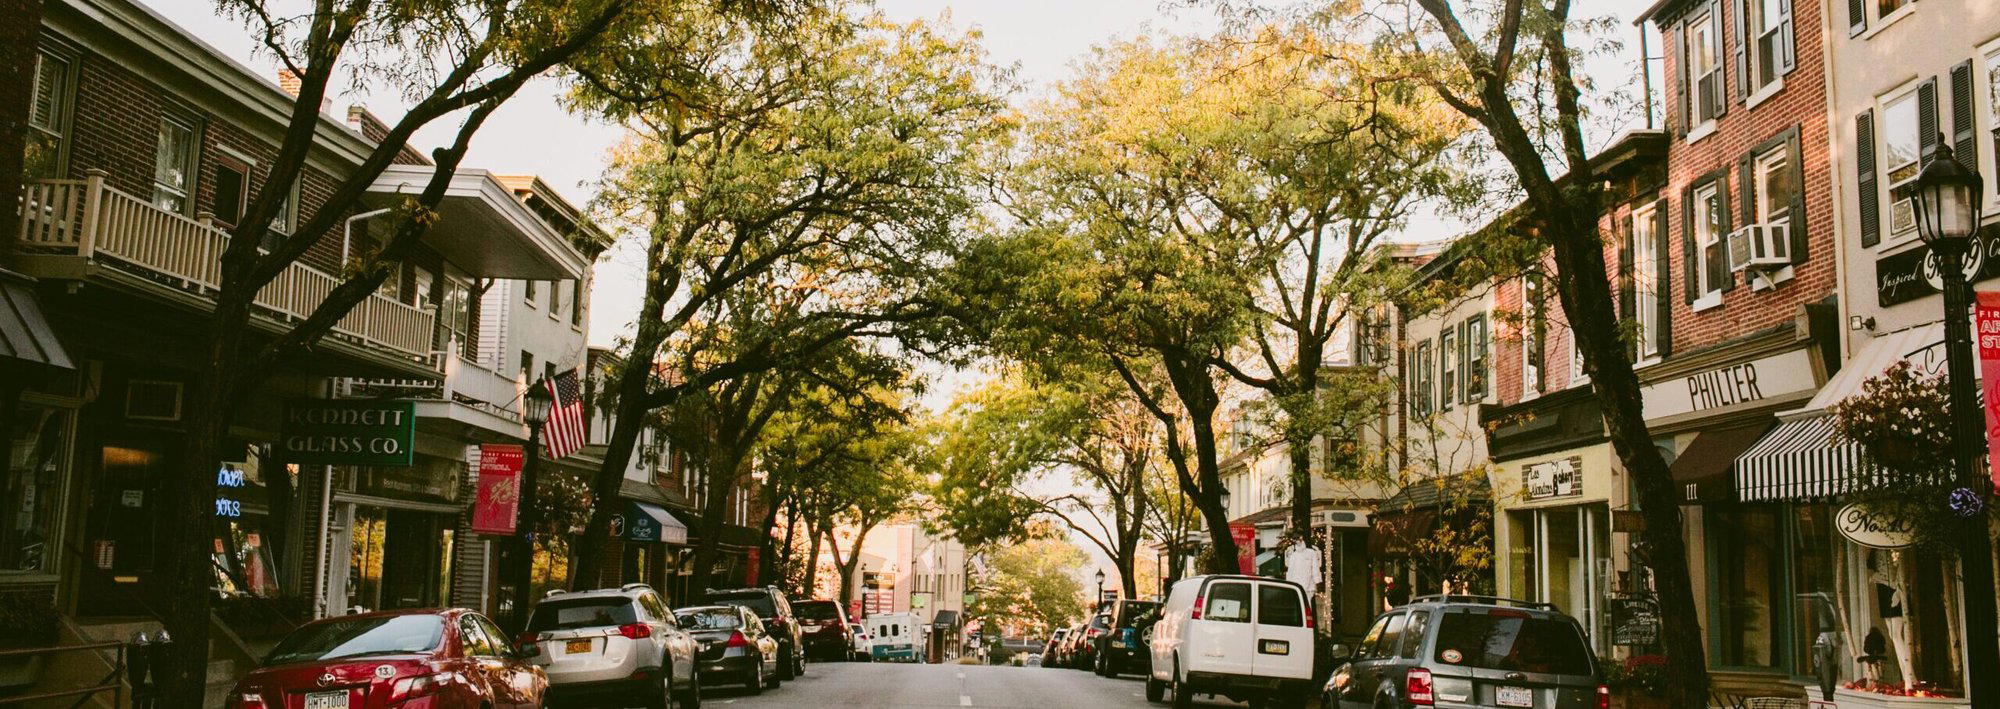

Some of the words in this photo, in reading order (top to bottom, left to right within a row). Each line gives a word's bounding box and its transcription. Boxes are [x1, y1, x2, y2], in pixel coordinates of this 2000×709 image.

[1880, 260, 1921, 297] Inspired
[1687, 363, 1764, 411] PHILTER
[289, 408, 404, 426] KENNETT
[286, 436, 362, 453] GLASS
[370, 437, 403, 454] CO.
[1686, 483, 1698, 501] 111
